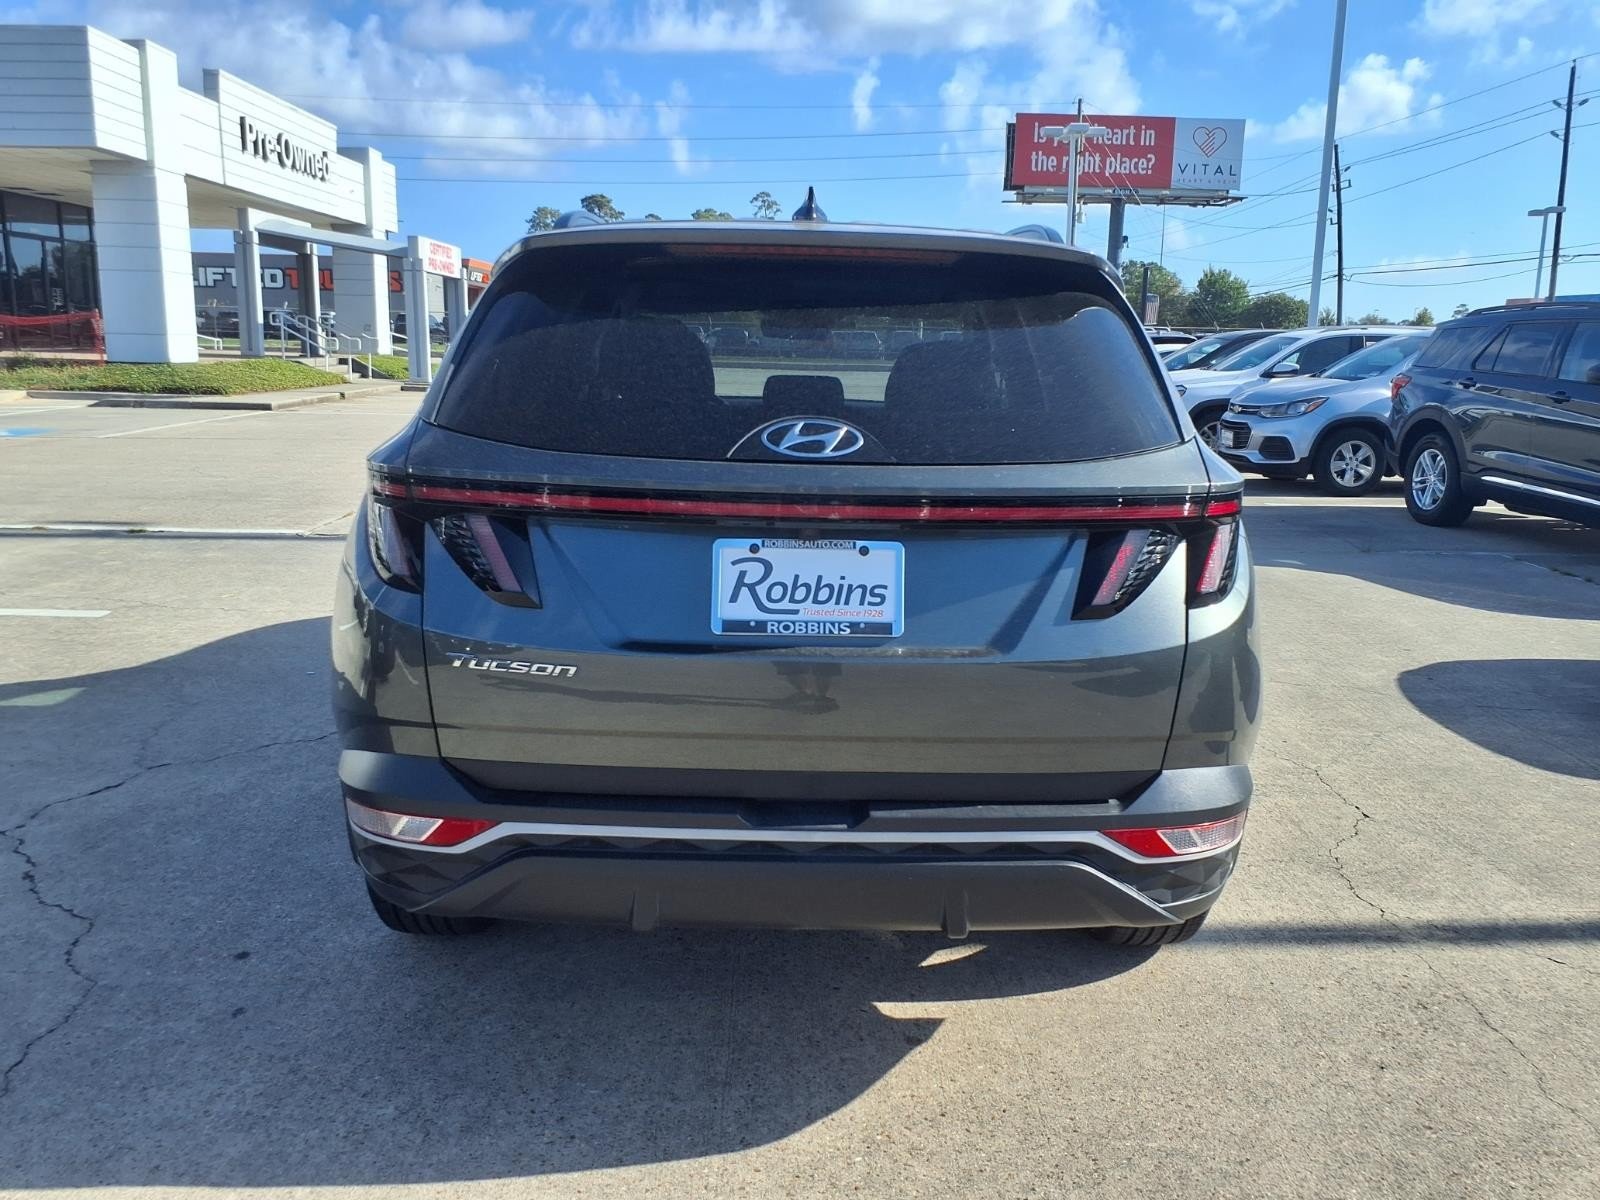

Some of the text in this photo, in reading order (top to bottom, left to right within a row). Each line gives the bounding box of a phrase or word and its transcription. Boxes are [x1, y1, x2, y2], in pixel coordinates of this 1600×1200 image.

[1140, 125, 1156, 146] in
[240, 116, 330, 182] Pre-Owned
[1031, 151, 1057, 172] the
[1105, 153, 1156, 176] place?
[1178, 163, 1238, 177] VITAL
[764, 539, 853, 549] ROBBINSAUTO.COM
[728, 556, 888, 615] Robbins
[803, 608, 884, 618] Trusted Since 1928
[767, 621, 851, 635] ROBBINS
